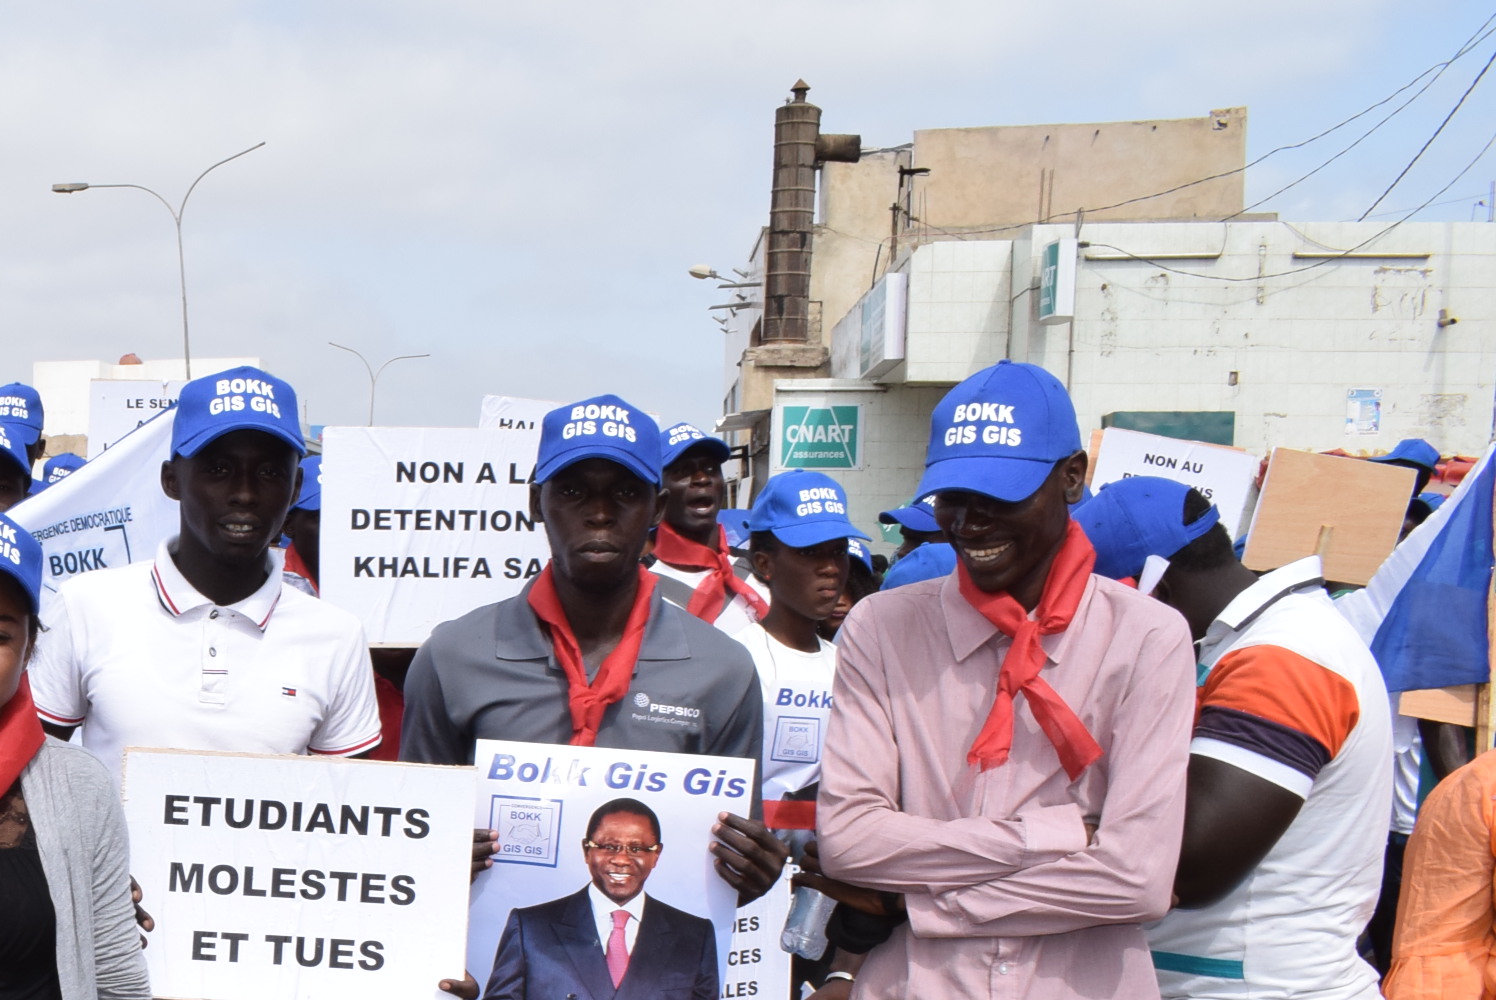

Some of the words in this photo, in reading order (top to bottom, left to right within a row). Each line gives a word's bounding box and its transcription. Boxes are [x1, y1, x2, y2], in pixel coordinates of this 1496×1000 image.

[216, 378, 274, 399] BOKK
[12, 407, 28, 419] GIS
[127, 399, 144, 409] LE
[209, 397, 245, 416] GIS
[251, 397, 281, 419] GIS
[571, 404, 629, 424] BOKK
[953, 402, 1015, 424] BOKK
[562, 421, 596, 440] GIS
[603, 421, 637, 443] GIS
[668, 433, 690, 446] GIS
[785, 424, 854, 443] CNART
[944, 426, 976, 446] GIS
[982, 426, 1022, 447] GIS
[792, 450, 845, 459] assurances
[1143, 453, 1177, 469] NON
[1181, 461, 1204, 474] AU
[396, 461, 464, 483] NON
[476, 463, 497, 484] A
[799, 487, 838, 501] BOKK
[796, 502, 822, 516] GIS
[825, 501, 844, 514] GIS
[33, 521, 69, 541] ERGENCE
[70, 506, 133, 532] DEMOCRATIQUE
[351, 509, 535, 531] DETENTION
[49, 548, 108, 576] BOKK
[354, 556, 492, 579] KHALIFA
[776, 688, 833, 709] Bokk
[650, 703, 700, 718] PEPSICO
[783, 748, 795, 756] GIS
[487, 753, 591, 787] Bokk
[605, 762, 668, 792] Gis
[683, 767, 747, 798] Gis
[164, 794, 430, 839] ETUDIANTS
[510, 811, 542, 821] BOKK
[503, 844, 521, 853] GIS
[524, 846, 542, 855] GIS
[168, 862, 416, 906] MOLESTES
[192, 931, 249, 963] ET
[265, 934, 385, 972] TUES
